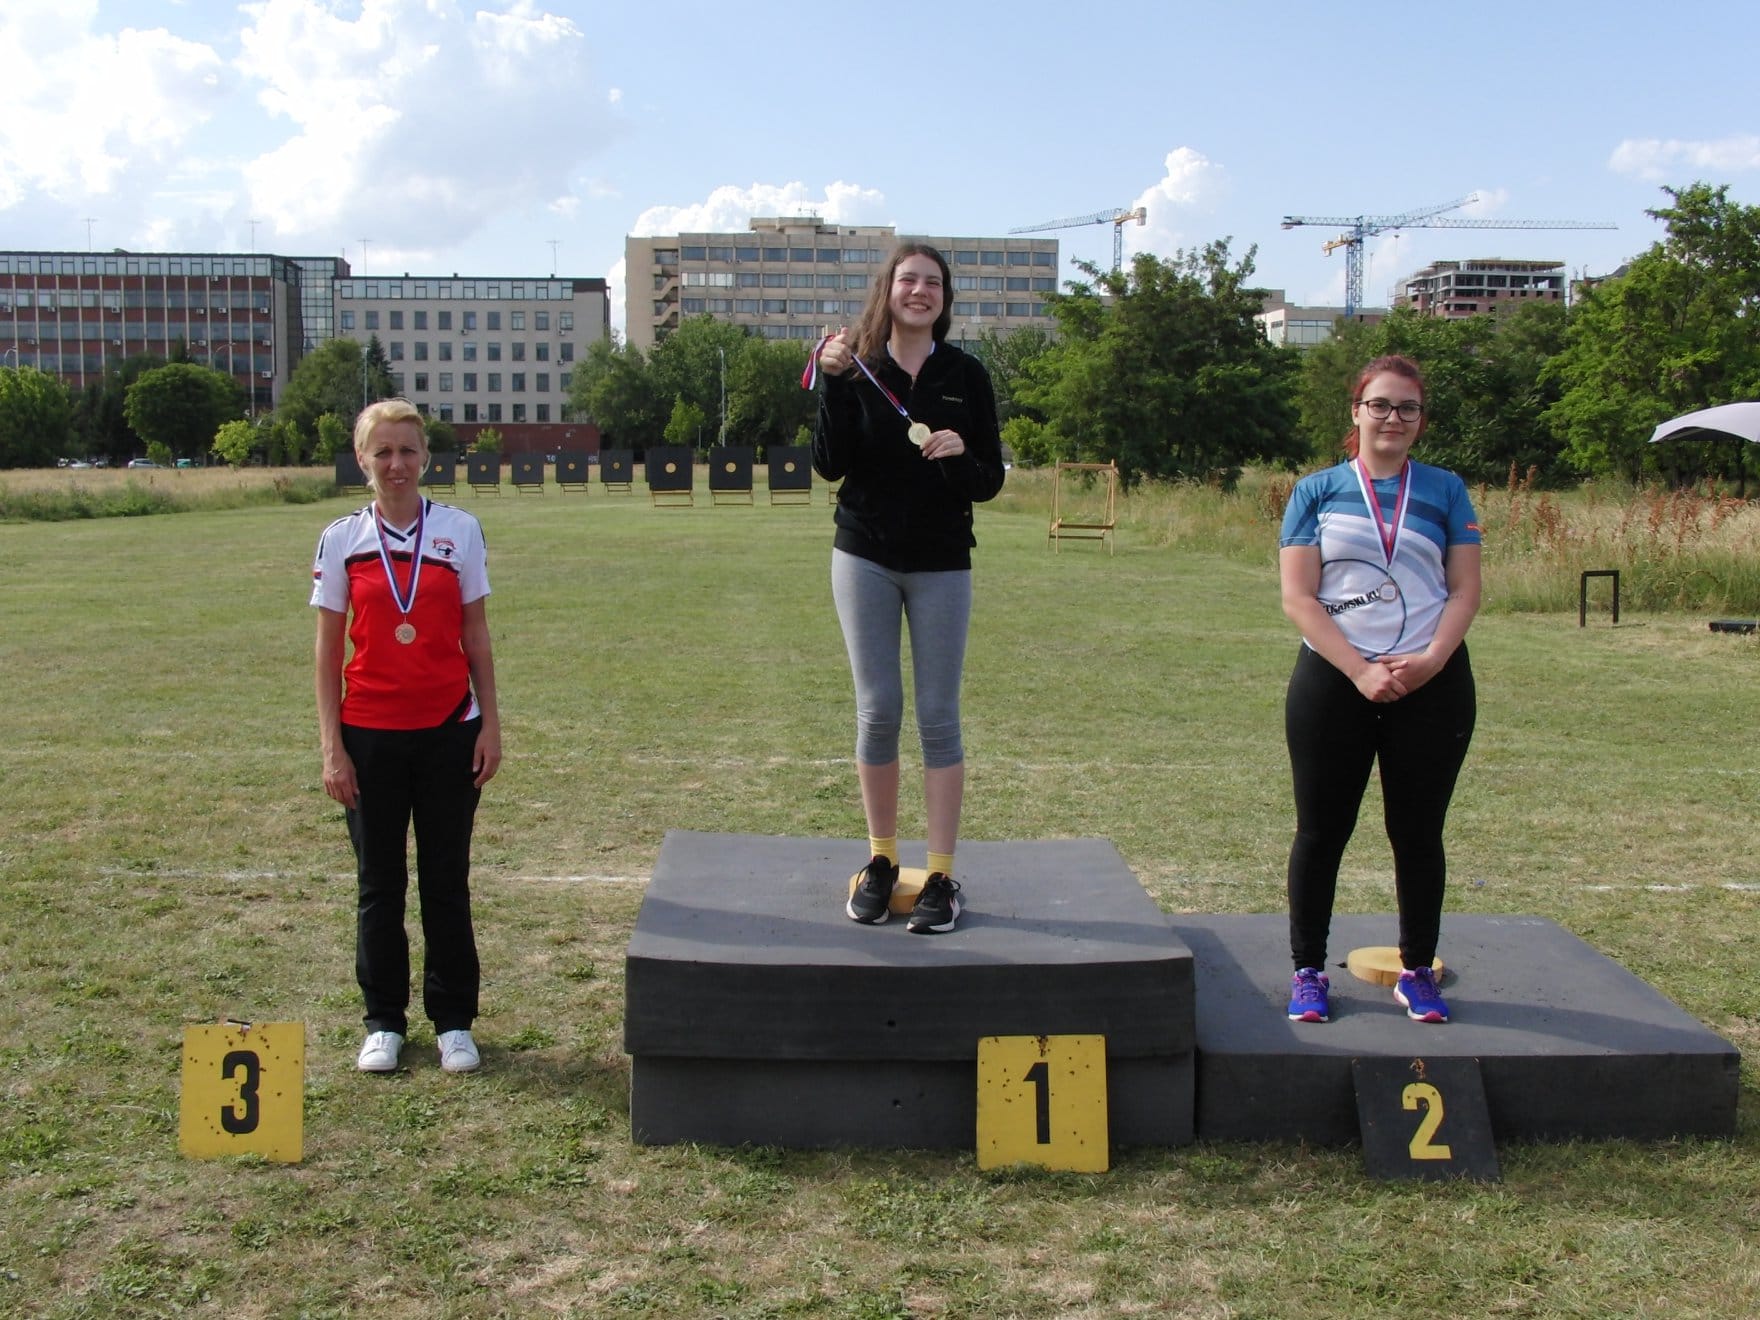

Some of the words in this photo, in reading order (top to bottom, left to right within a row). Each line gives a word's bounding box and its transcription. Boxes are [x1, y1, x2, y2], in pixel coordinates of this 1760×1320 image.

[221, 1050, 260, 1134] 3
[1023, 1062, 1050, 1144] 1
[1402, 1082, 1451, 1159] 2
